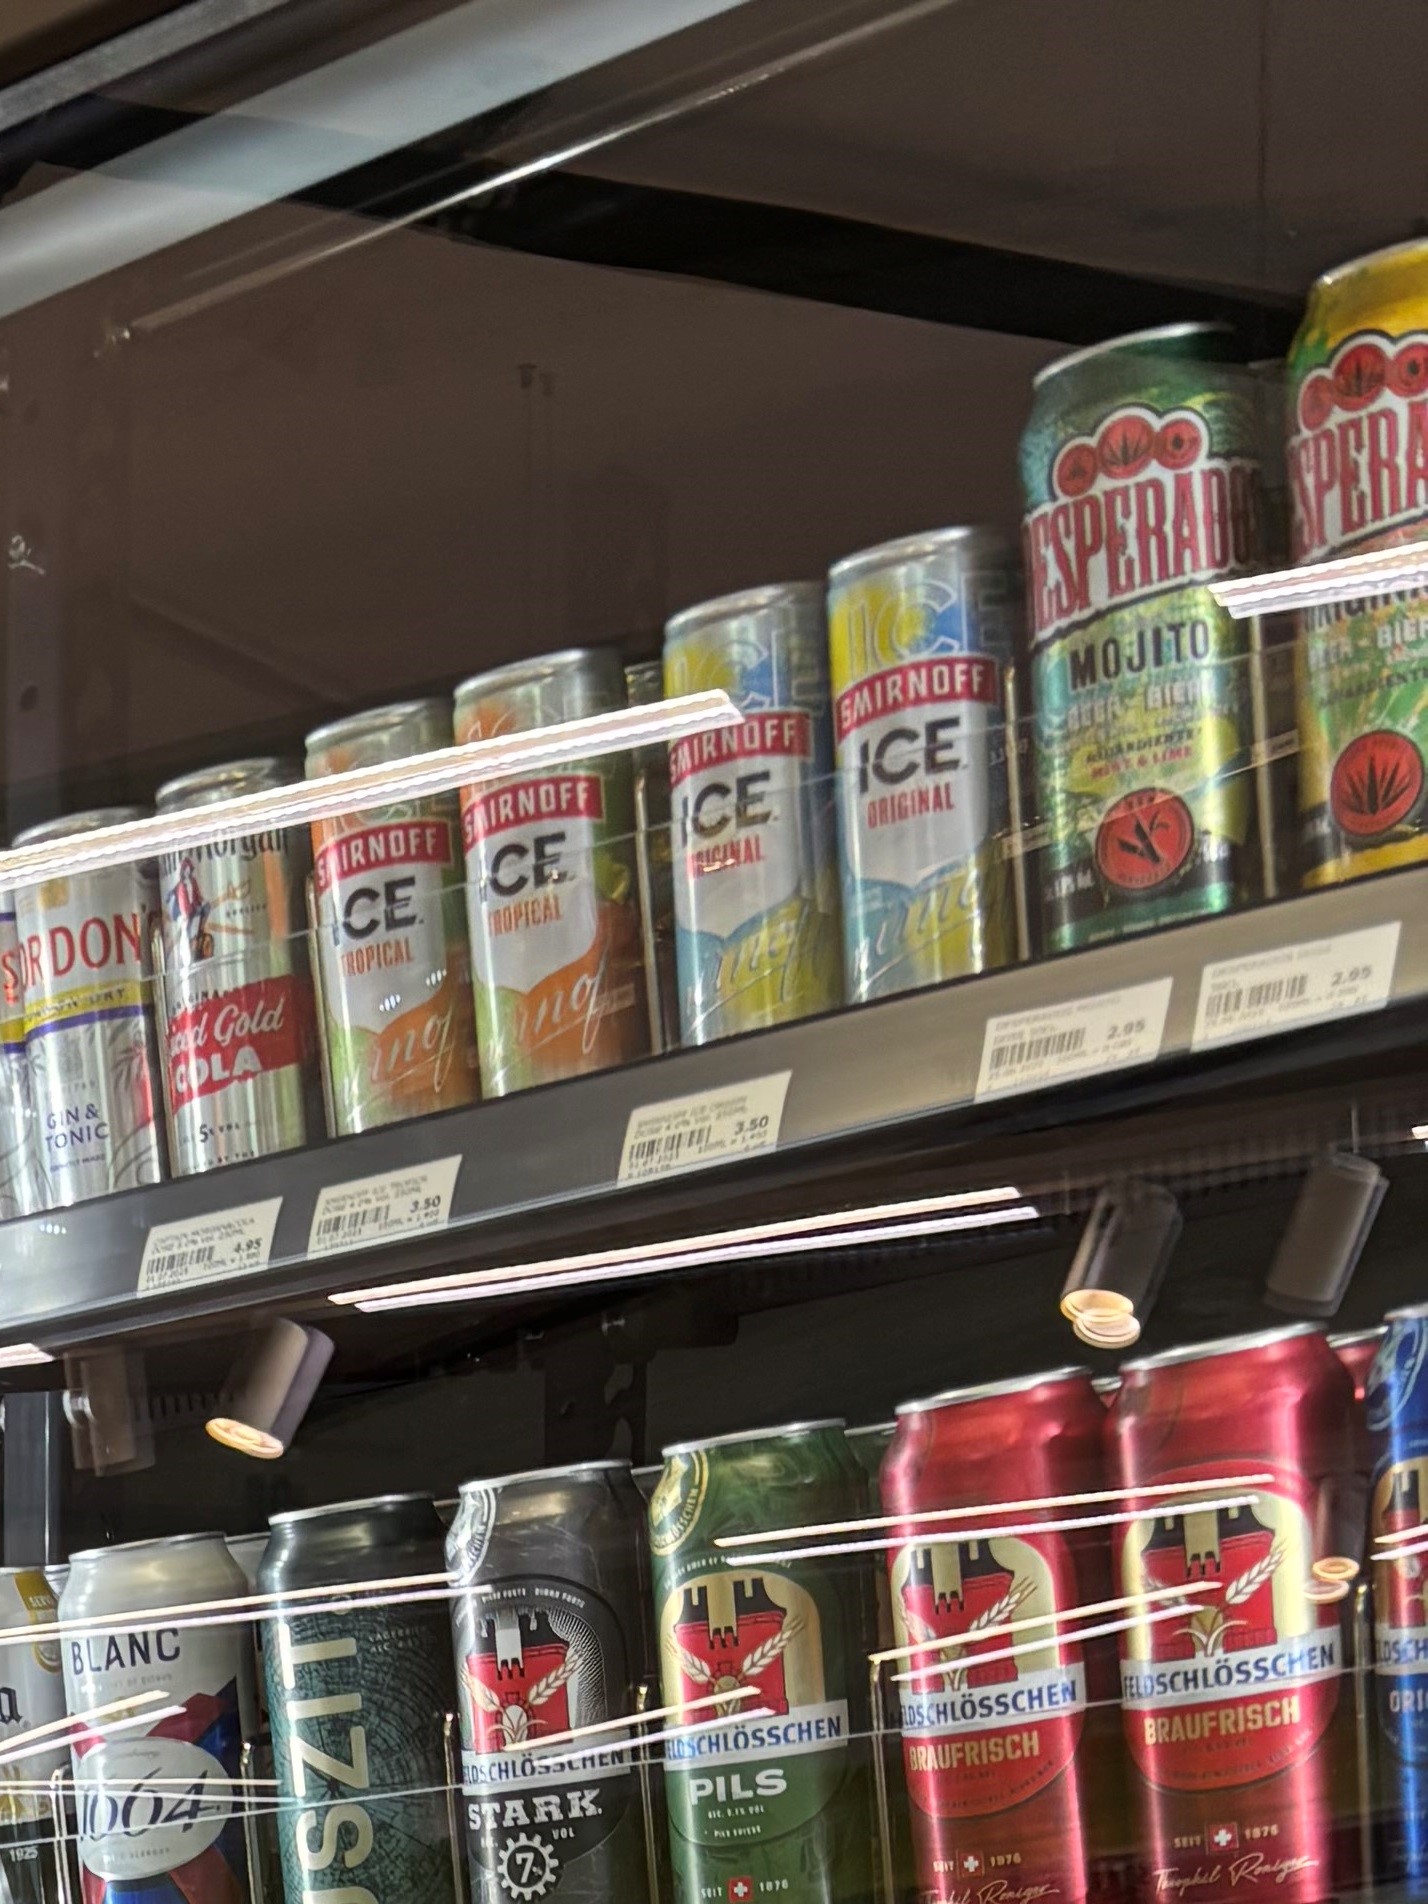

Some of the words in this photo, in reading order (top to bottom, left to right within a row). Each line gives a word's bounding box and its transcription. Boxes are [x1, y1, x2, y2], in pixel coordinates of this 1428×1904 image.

[1070, 619, 1211, 692] MOJITO
[840, 663, 985, 728] SMIRNOFF
[859, 716, 961, 795] ICE
[681, 770, 771, 848] ICE
[867, 783, 955, 829] ORIGINAL
[1331, 964, 1375, 989] 2.95
[214, 998, 285, 1047] Gold
[1107, 1019, 1147, 1042] 2.95
[173, 1050, 263, 1096] COLA
[45, 1107, 80, 1130] GIN
[85, 1103, 99, 1120] &
[45, 1123, 110, 1151] TONIC
[734, 1114, 770, 1137] 3.50
[409, 1195, 441, 1213] 3.50
[70, 1627, 182, 1676] BLANC
[1144, 1696, 1300, 1745] BRAUFRISCH
[909, 1731, 1040, 1772] BRAUFRISCH
[689, 1769, 787, 1806] PILS
